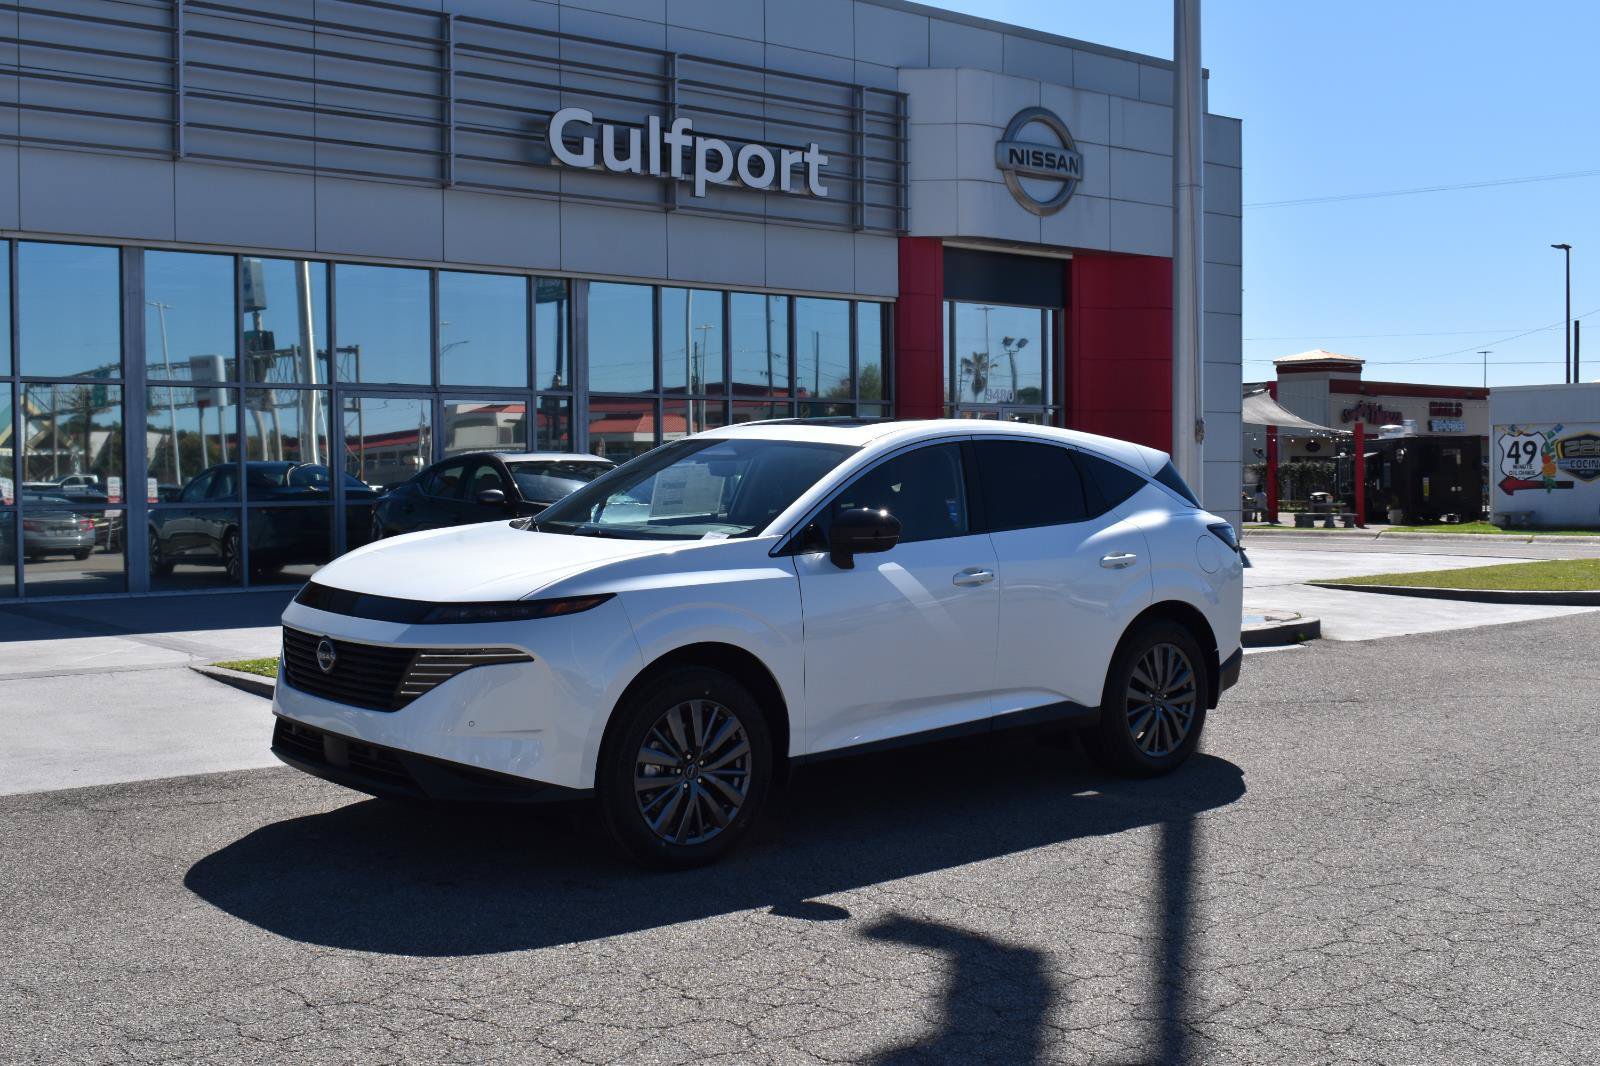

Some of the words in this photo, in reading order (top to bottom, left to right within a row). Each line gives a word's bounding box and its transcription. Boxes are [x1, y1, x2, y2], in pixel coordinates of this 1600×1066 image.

[547, 107, 829, 198] Gulfport
[1008, 148, 1079, 174] NISSAN
[1506, 441, 1537, 464] 49
[1570, 459, 1600, 468] COCIN
